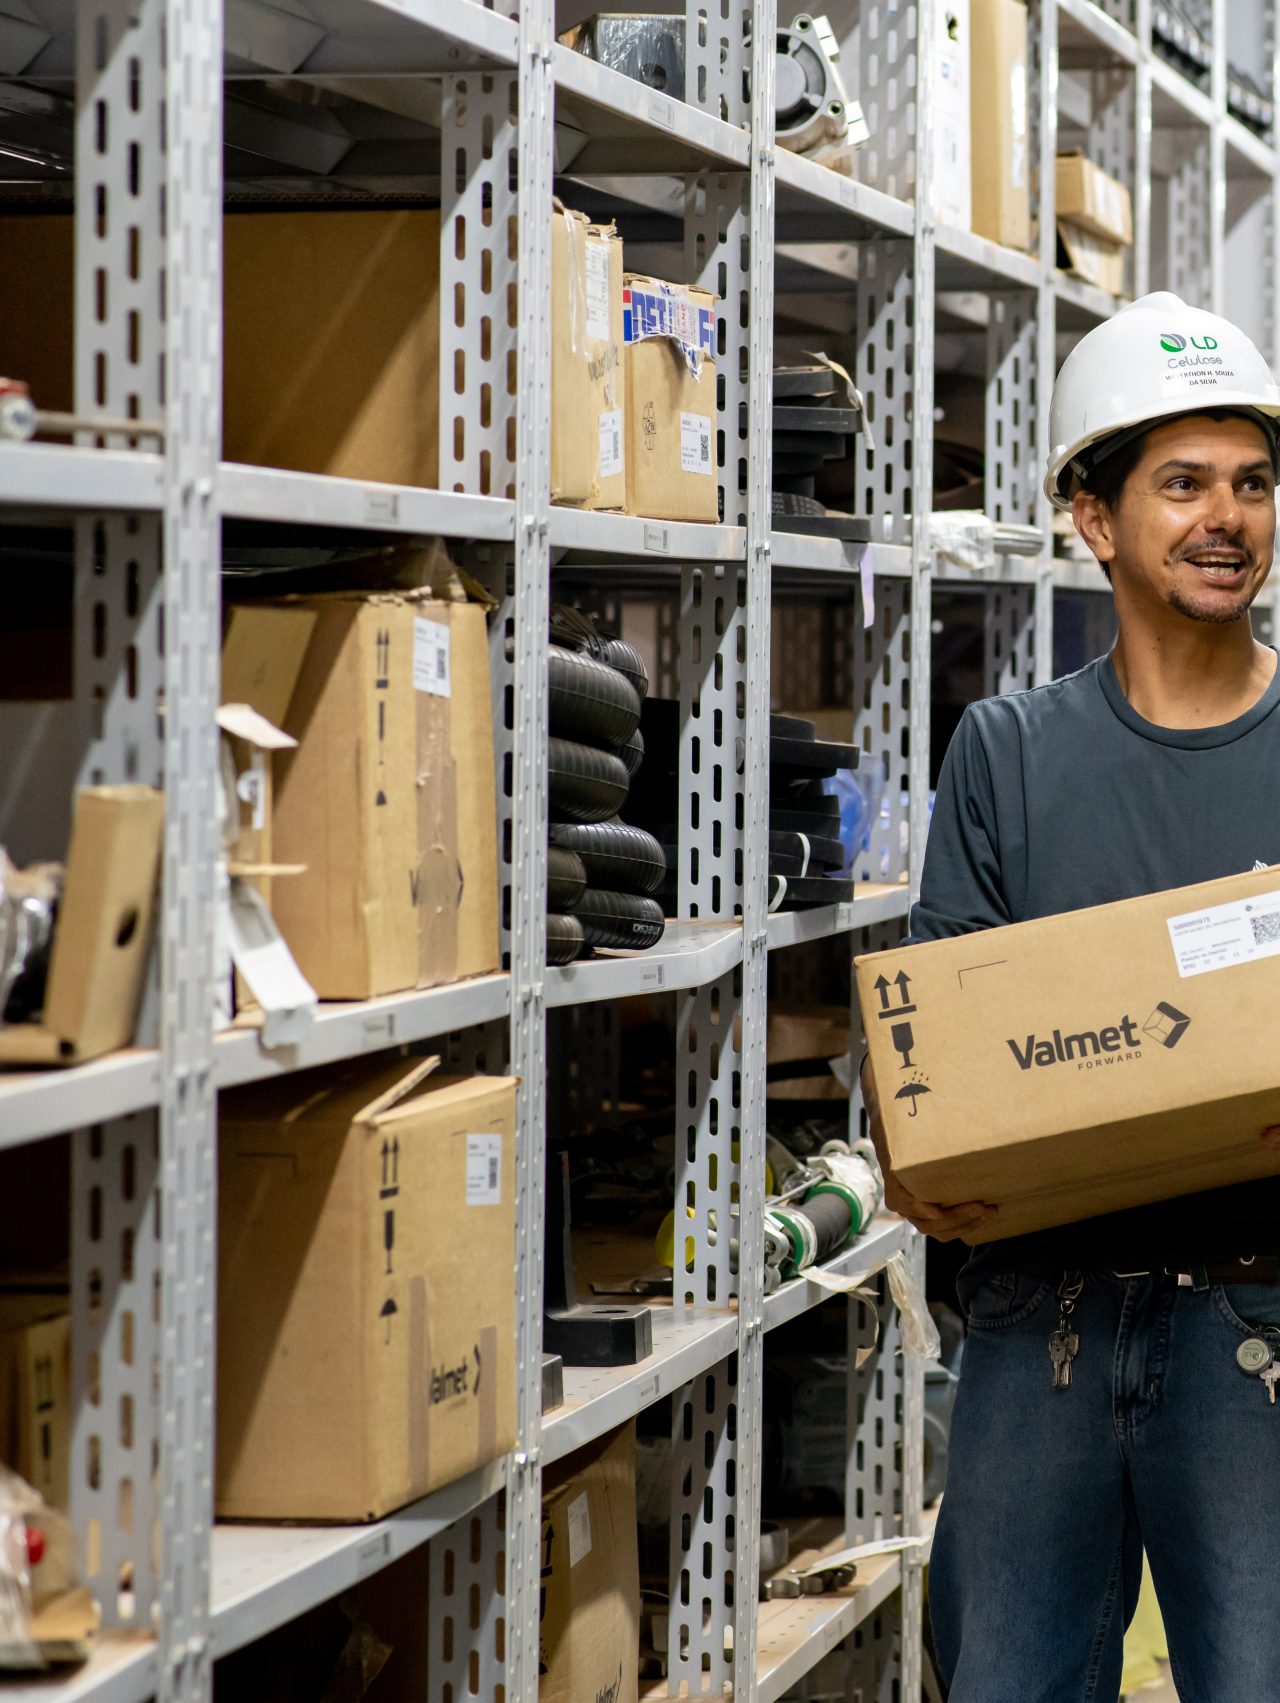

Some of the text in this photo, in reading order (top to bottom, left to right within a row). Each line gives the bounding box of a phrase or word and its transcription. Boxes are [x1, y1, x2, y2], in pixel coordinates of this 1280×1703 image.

[1190, 336, 1218, 350] LD
[1167, 354, 1223, 369] Celulose
[1005, 1014, 1141, 1071] Valmet
[1077, 1050, 1143, 1071] FORWARD
